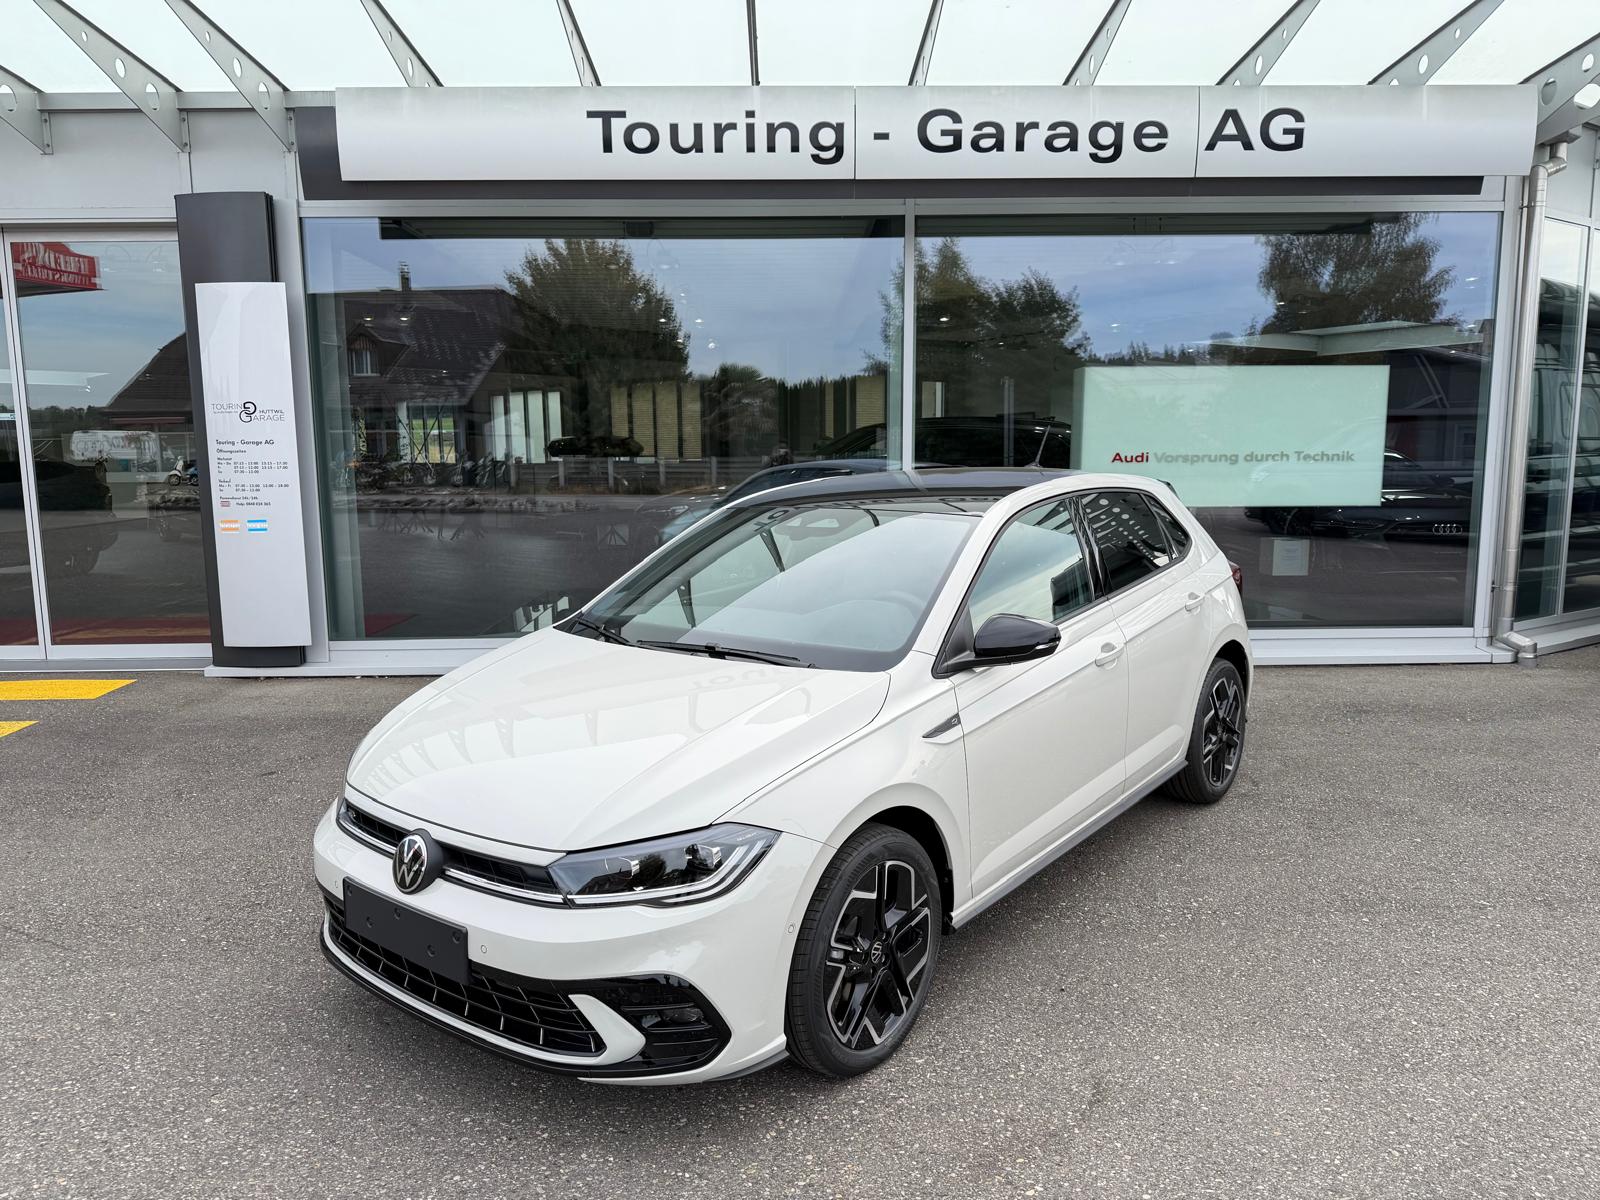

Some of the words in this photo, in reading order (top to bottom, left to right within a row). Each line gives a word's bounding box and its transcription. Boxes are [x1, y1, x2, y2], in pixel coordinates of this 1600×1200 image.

[586, 109, 845, 165] Touring
[873, 132, 890, 141] -
[916, 107, 1169, 164] Garage
[1204, 107, 1305, 152] AG
[1111, 451, 1149, 463] Audi
[1154, 451, 1239, 466] Vorsprung
[1243, 450, 1290, 463] durch
[1295, 450, 1356, 463] Technik
